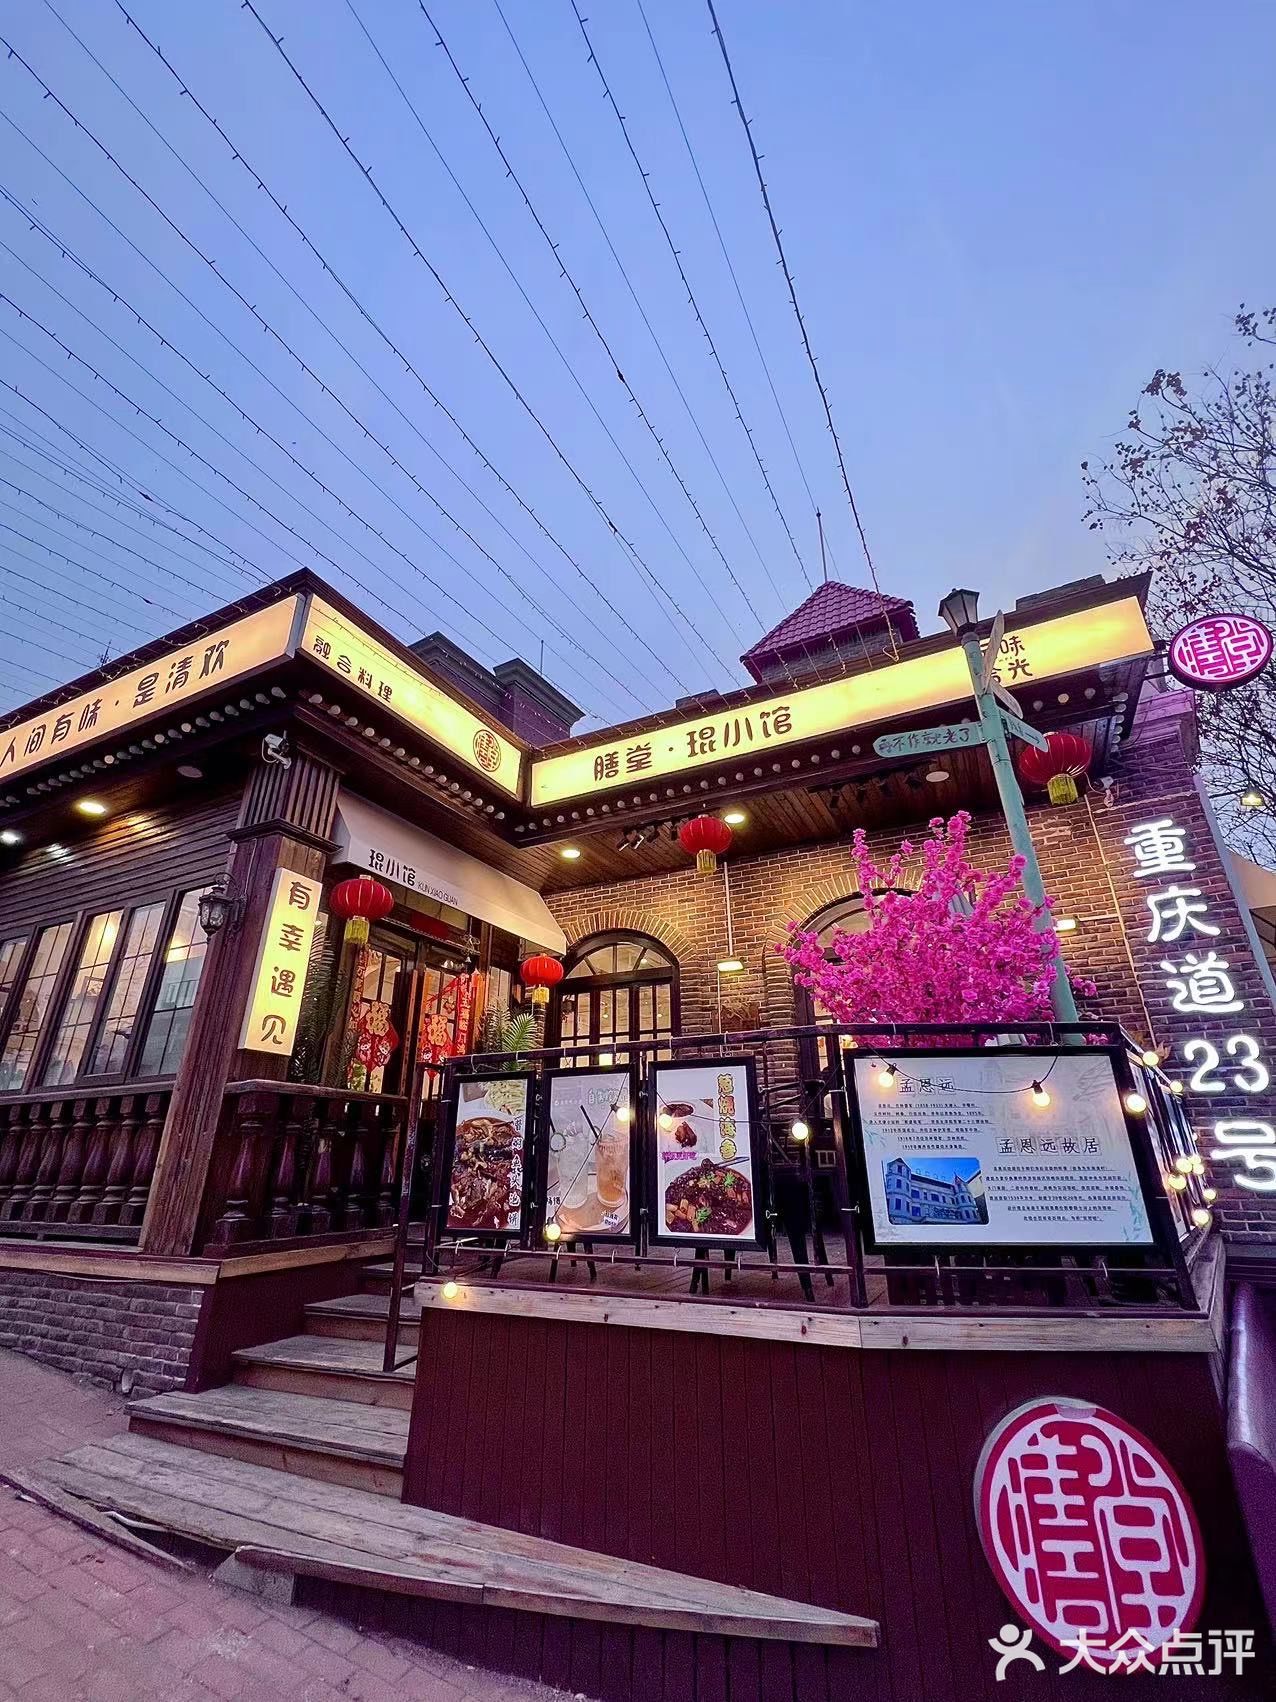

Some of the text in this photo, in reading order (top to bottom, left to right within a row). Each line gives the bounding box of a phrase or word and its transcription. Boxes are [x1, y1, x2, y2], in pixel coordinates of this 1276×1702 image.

[313, 635, 392, 703] 融合料理
[368, 848, 416, 886] 琨小馆
[261, 881, 312, 1045] 有幸遇见
[999, 1137, 1100, 1154] 孟恩远故居
